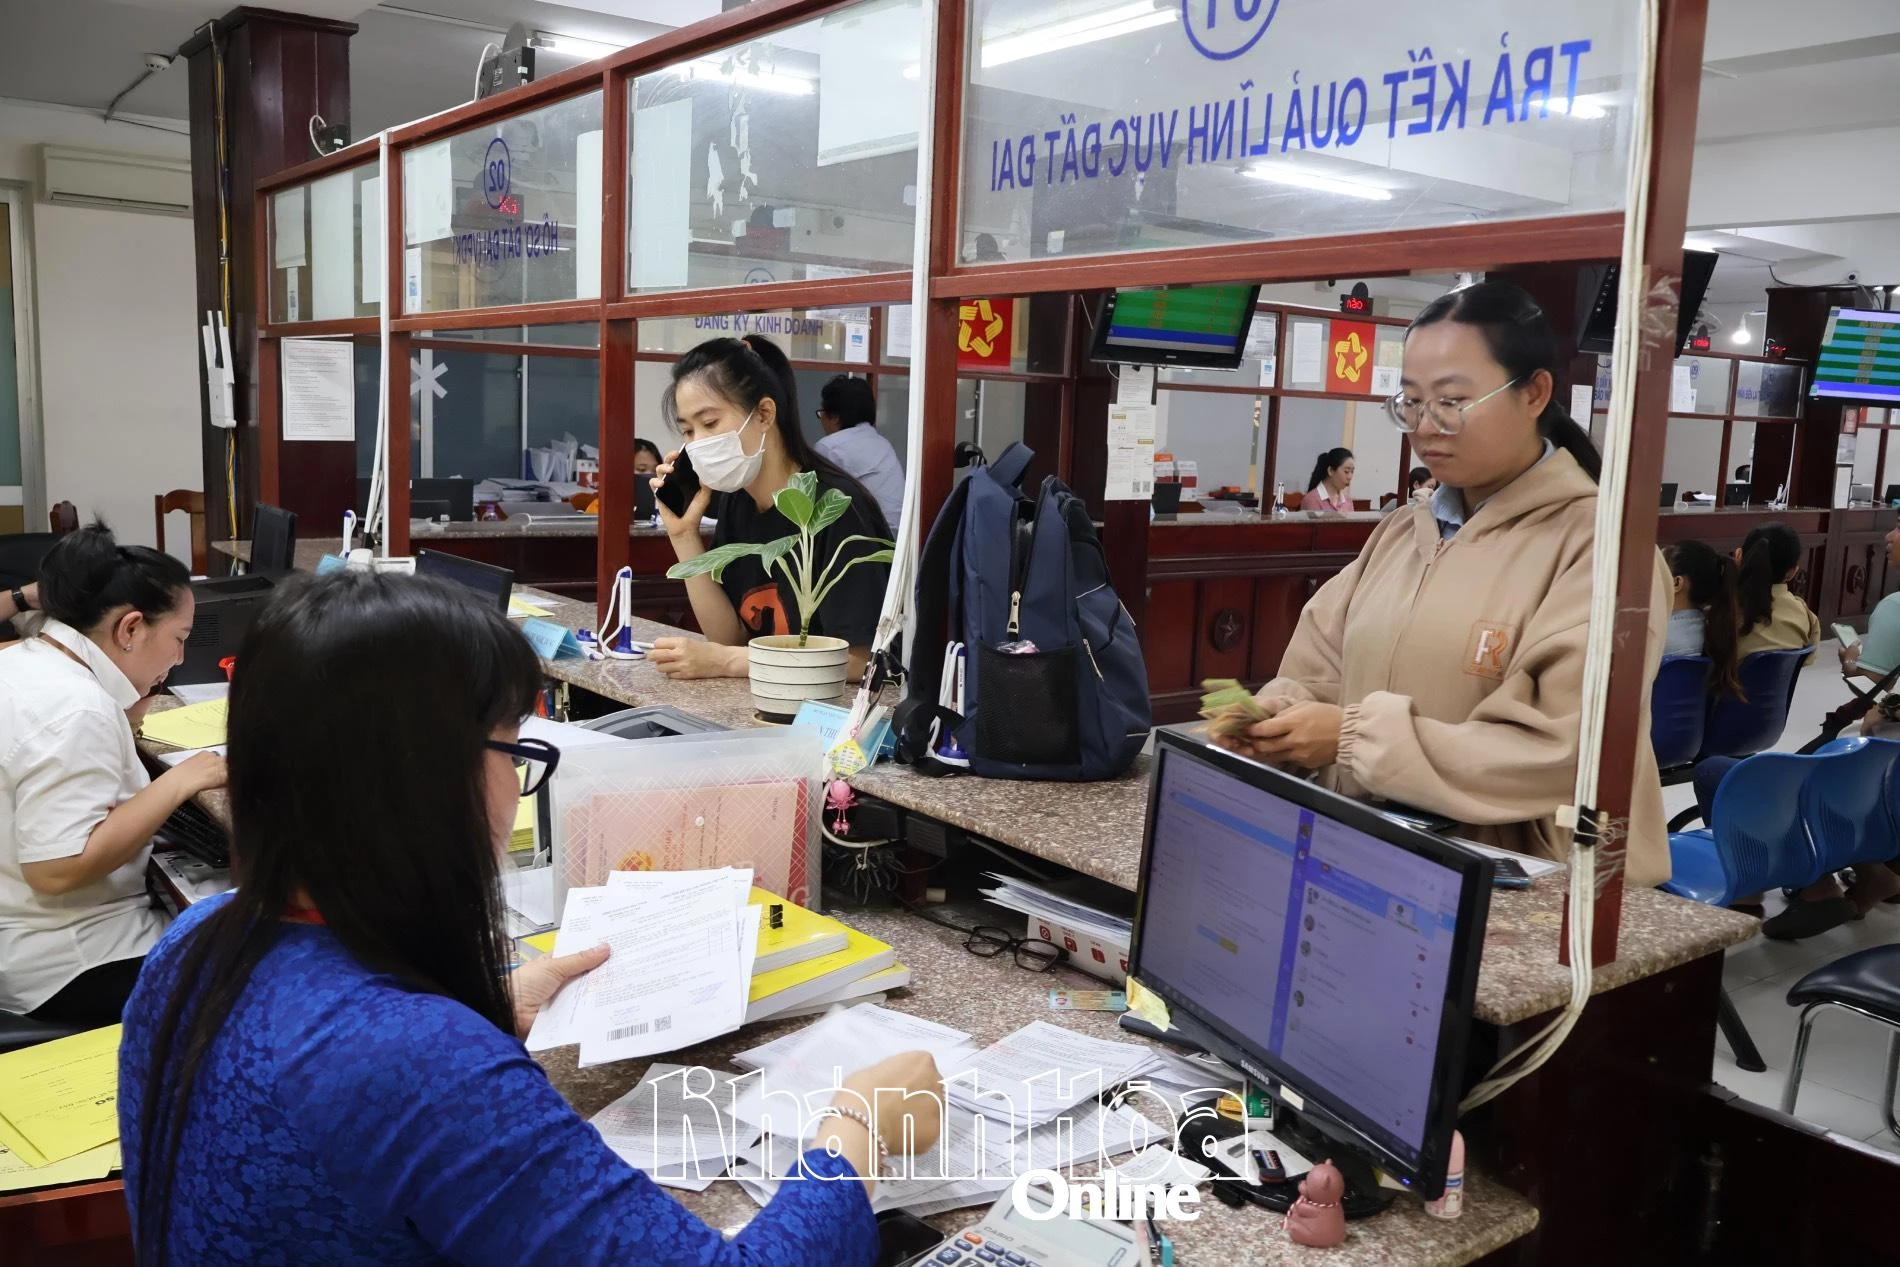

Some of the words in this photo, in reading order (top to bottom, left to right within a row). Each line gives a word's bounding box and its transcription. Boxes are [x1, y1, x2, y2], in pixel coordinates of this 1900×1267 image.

[755, 316, 781, 333] KINH
[784, 318, 824, 336] DOANH
[1240, 1059, 1270, 1085] SAMSUNG
[983, 1226, 1014, 1242] CASIO
